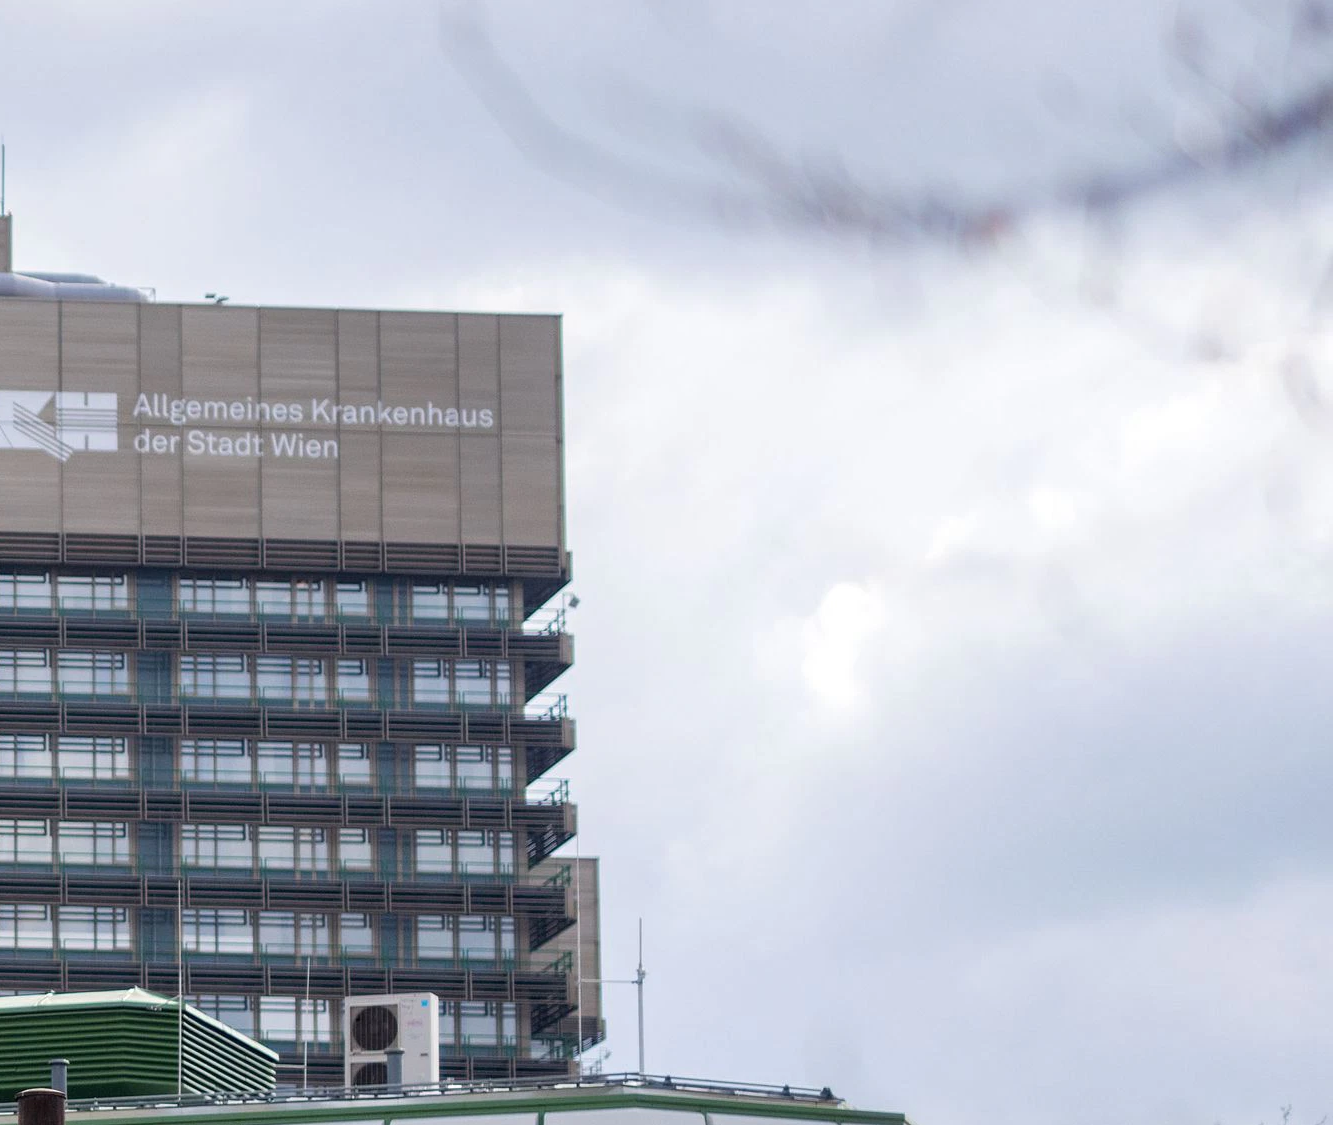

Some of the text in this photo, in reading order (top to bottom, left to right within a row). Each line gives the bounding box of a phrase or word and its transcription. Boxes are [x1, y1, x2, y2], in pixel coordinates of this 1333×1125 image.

[134, 392, 494, 428] Allgemeines Krankenhaus
[134, 428, 339, 459] der Stadt Wien
